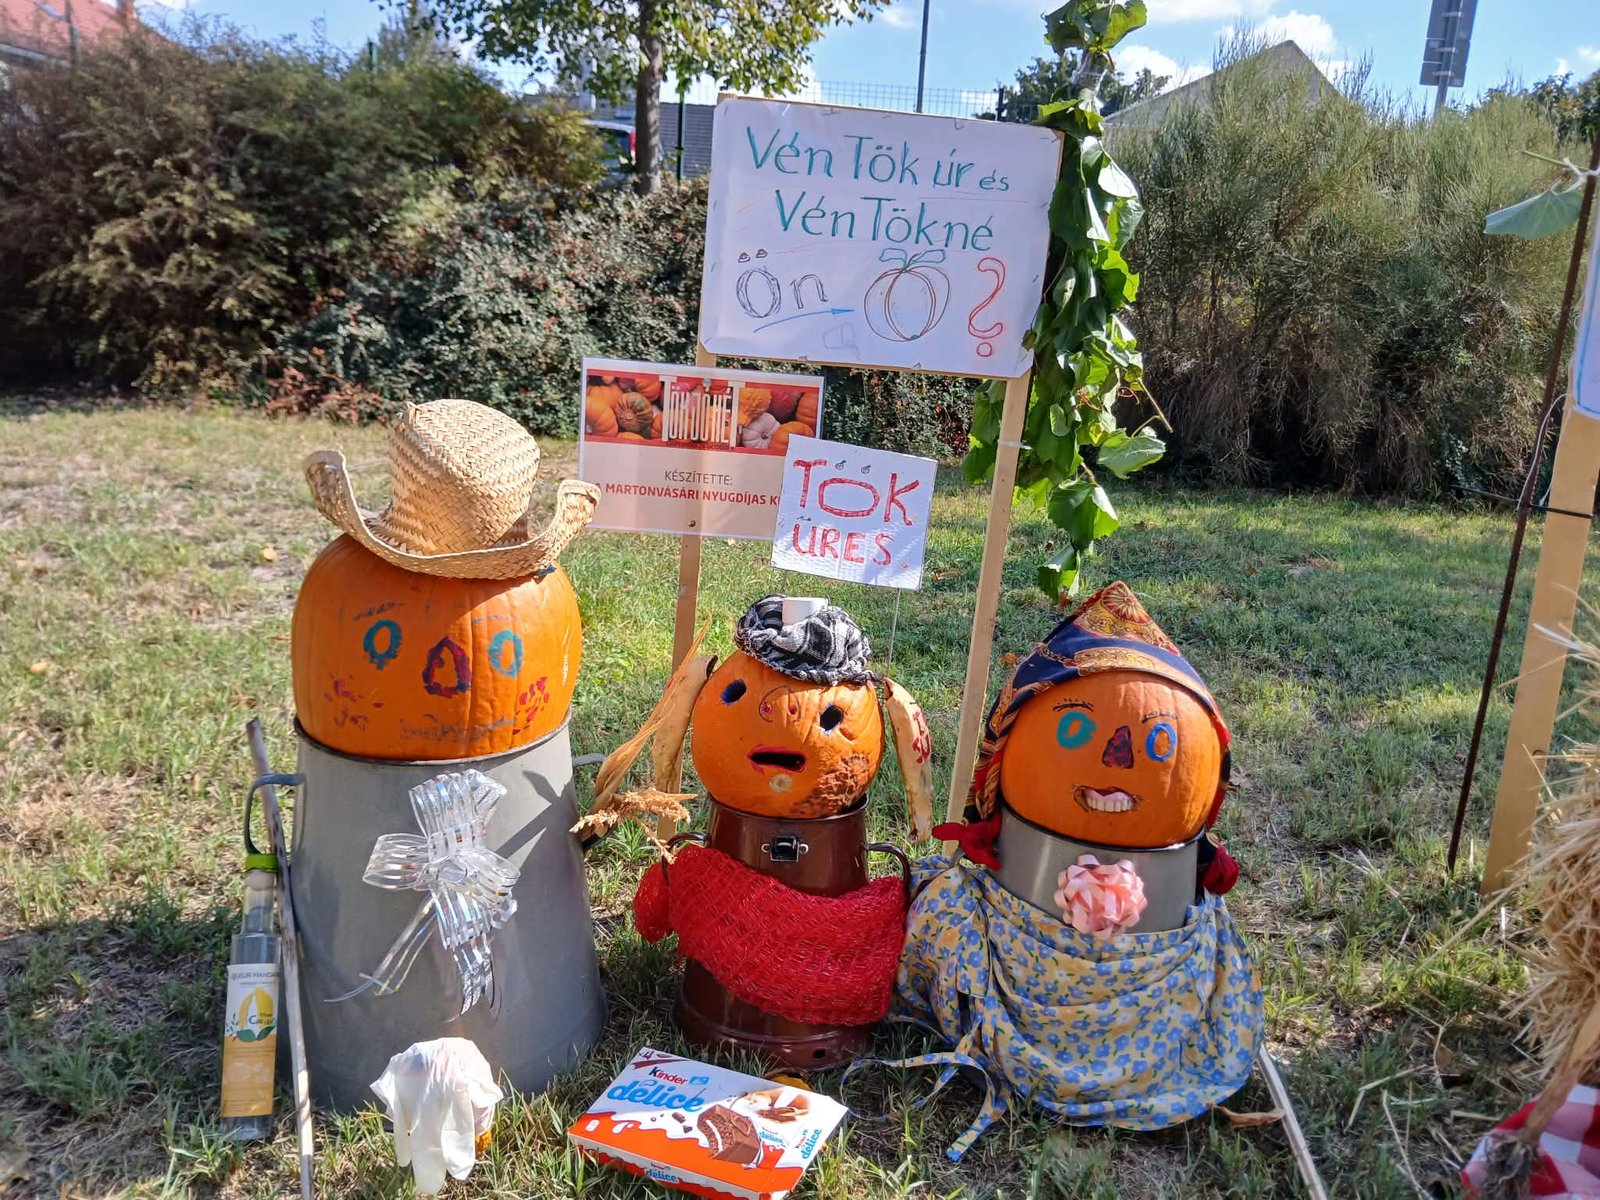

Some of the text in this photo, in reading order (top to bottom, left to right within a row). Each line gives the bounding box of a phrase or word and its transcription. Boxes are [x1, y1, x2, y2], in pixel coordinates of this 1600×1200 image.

[746, 126, 1009, 191] Vén Tök úr és
[775, 189, 855, 238] Vén
[605, 483, 699, 500] MARTONVÁSÁRI
[702, 490, 766, 506] NYUGDÍJAS
[664, 469, 733, 486] KÉSZÍTETTE:
[793, 459, 919, 526] TÖK
